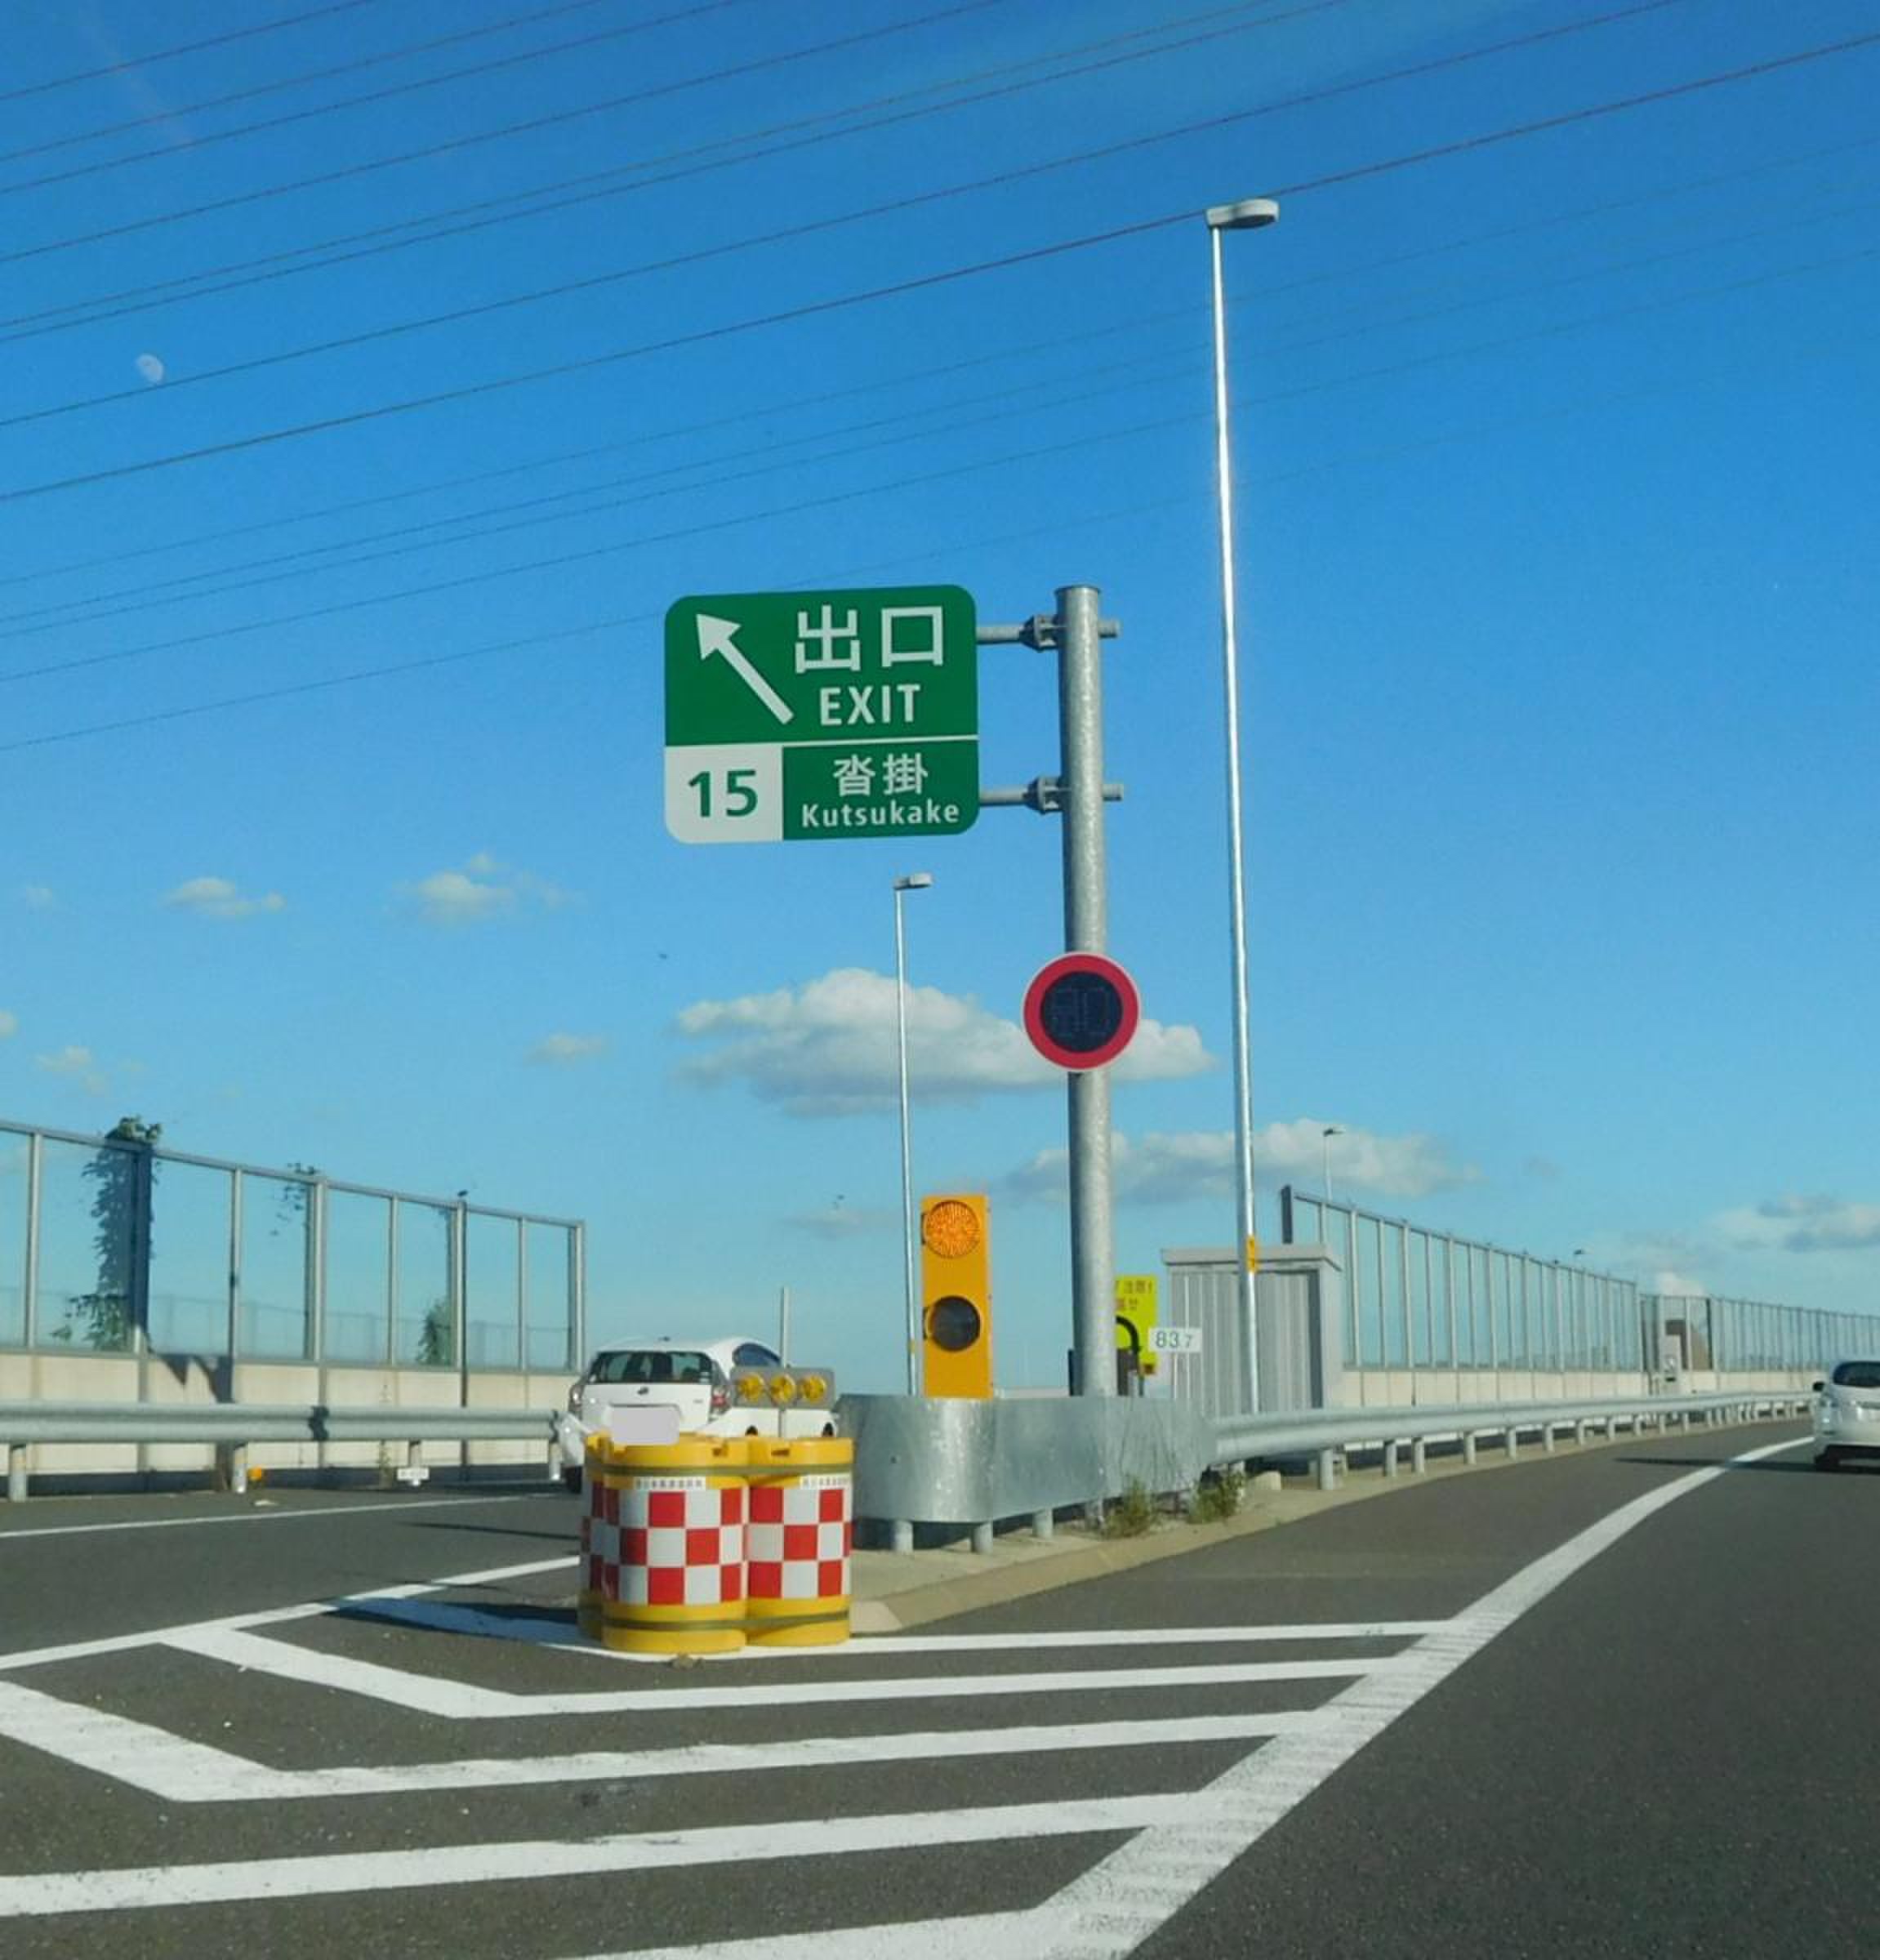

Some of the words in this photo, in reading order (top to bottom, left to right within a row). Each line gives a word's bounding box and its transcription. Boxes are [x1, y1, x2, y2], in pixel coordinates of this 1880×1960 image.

[795, 605, 943, 674] 出口
[820, 684, 920, 725] EXIT
[688, 769, 758, 817] 15
[833, 753, 928, 797] 沓掛
[801, 799, 960, 828] Kutsukake
